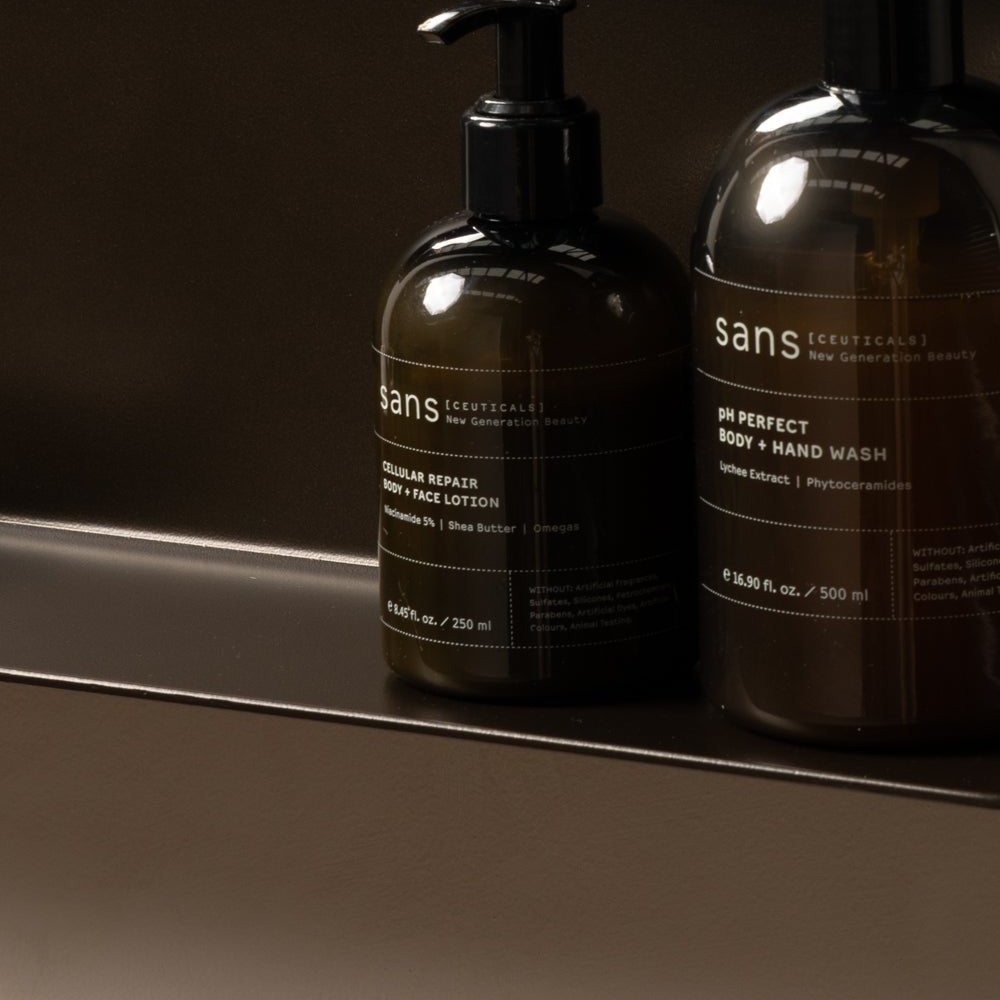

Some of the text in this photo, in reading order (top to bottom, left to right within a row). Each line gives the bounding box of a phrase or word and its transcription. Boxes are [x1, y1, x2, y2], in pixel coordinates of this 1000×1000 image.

[716, 317, 927, 359] sans [CEUTICALS]
[808, 349, 976, 363] New Generation Beauty
[380, 385, 439, 422] sans
[446, 415, 587, 427] New Generation Beauty
[718, 407, 809, 435] pH PERFECT
[719, 427, 887, 461] BODY + HAND WASH
[382, 460, 478, 489] CELLULAR REPAIR
[719, 460, 748, 478] Lychee
[749, 469, 790, 485] Extract
[806, 477, 912, 491] Phytoceramides
[383, 478, 500, 508] BODY + FACE LOTION
[384, 504, 421, 525] Niacinamide
[423, 517, 436, 528] 5%
[448, 521, 474, 532] Shea
[477, 522, 516, 533] Butter
[533, 522, 580, 534] Omegas
[912, 545, 965, 557] WITHOUT:
[913, 561, 963, 572] Sulfates,
[732, 571, 760, 590] 16.90
[763, 579, 777, 594] fl.
[780, 584, 801, 597] oz.
[804, 586, 816, 597] /
[820, 586, 847, 600] 500
[851, 588, 869, 601] ml
[913, 576, 967, 587] Parabens,
[913, 592, 959, 601] Colours,
[961, 587, 994, 599] Animal
[410, 609, 420, 622] fl.
[422, 615, 438, 626] oz.
[452, 617, 474, 630] 250
[477, 619, 492, 631] ml
